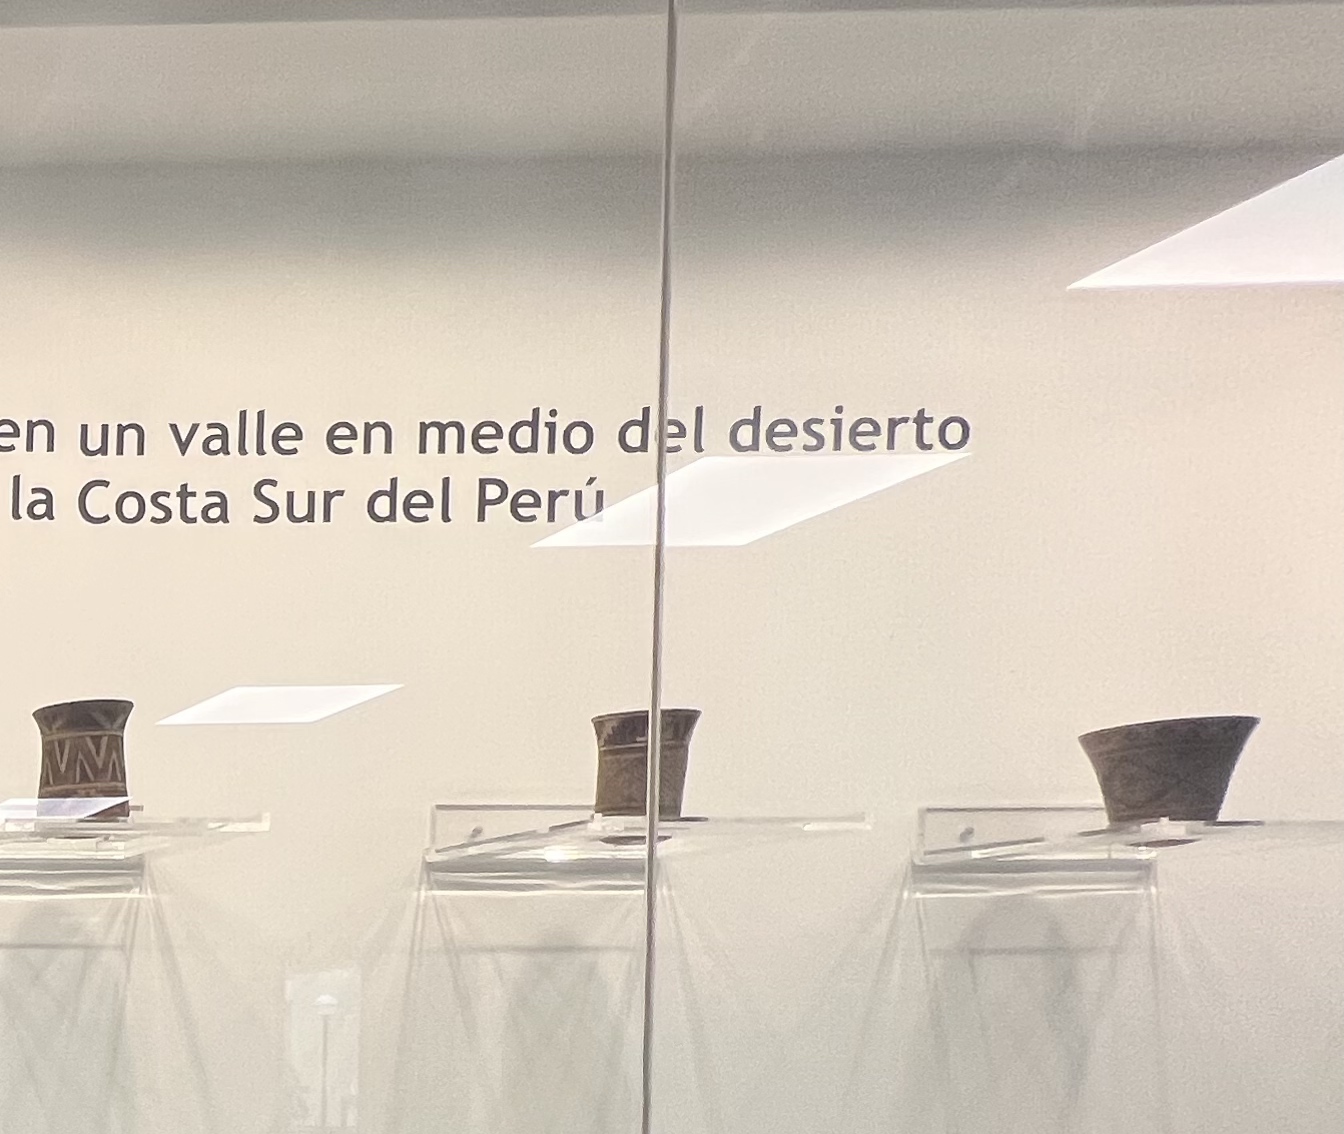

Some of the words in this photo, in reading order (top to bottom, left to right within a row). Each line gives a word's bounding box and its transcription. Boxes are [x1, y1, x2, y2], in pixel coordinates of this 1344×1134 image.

[79, 422, 146, 457] un
[168, 409, 304, 457] valle
[325, 420, 393, 456] en
[418, 406, 595, 455] medio
[618, 405, 706, 454] del
[728, 404, 971, 453] desierto
[11, 474, 55, 521] la
[77, 478, 230, 525] Costa
[252, 478, 346, 525] Sur
[366, 476, 452, 524] del
[476, 476, 605, 524] Perú
